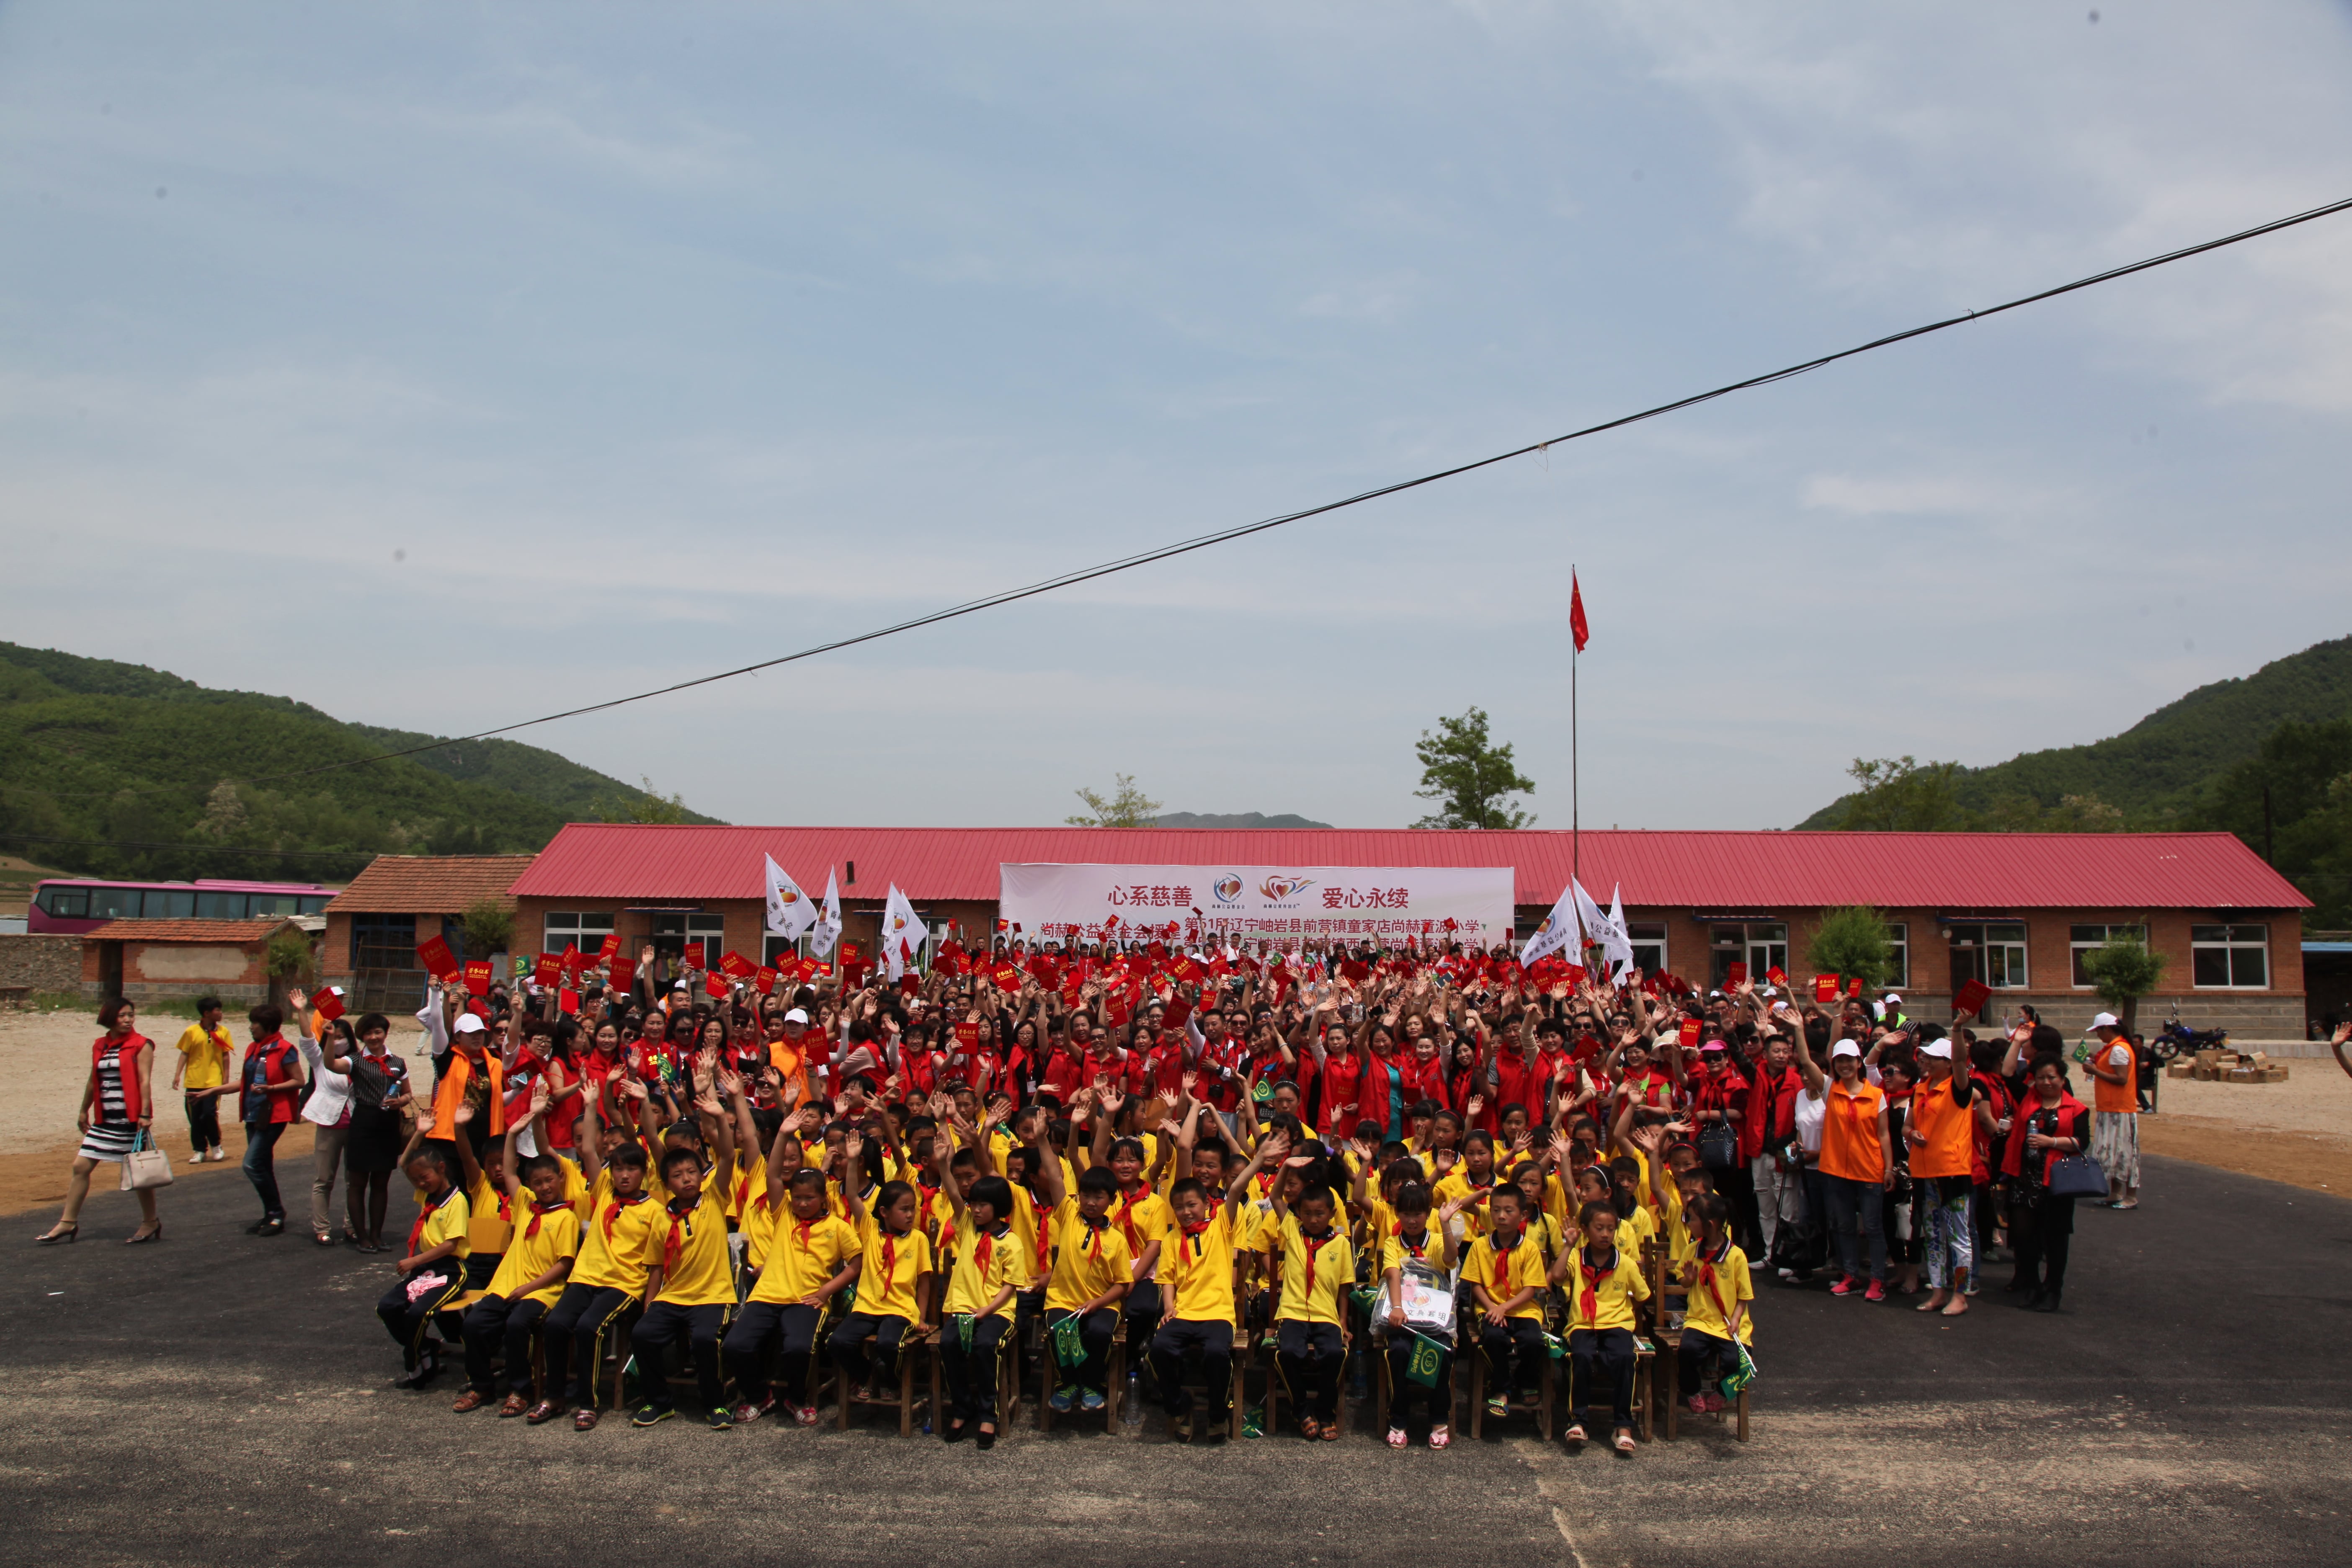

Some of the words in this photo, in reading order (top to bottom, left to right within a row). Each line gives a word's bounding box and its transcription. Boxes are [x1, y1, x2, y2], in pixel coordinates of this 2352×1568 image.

[1108, 885, 1192, 907] 心系慈善
[1322, 887, 1408, 909] 爱心永续
[996, 968, 1013, 978] 荣誉证书
[1174, 959, 1188, 973] 荣誉证书
[807, 1035, 824, 1044] 荣誉证书
[648, 1052, 668, 1062] 荣誉书
[1385, 1304, 1447, 1320] 尚文具套组
[1411, 1354, 1421, 1373] HOPE
